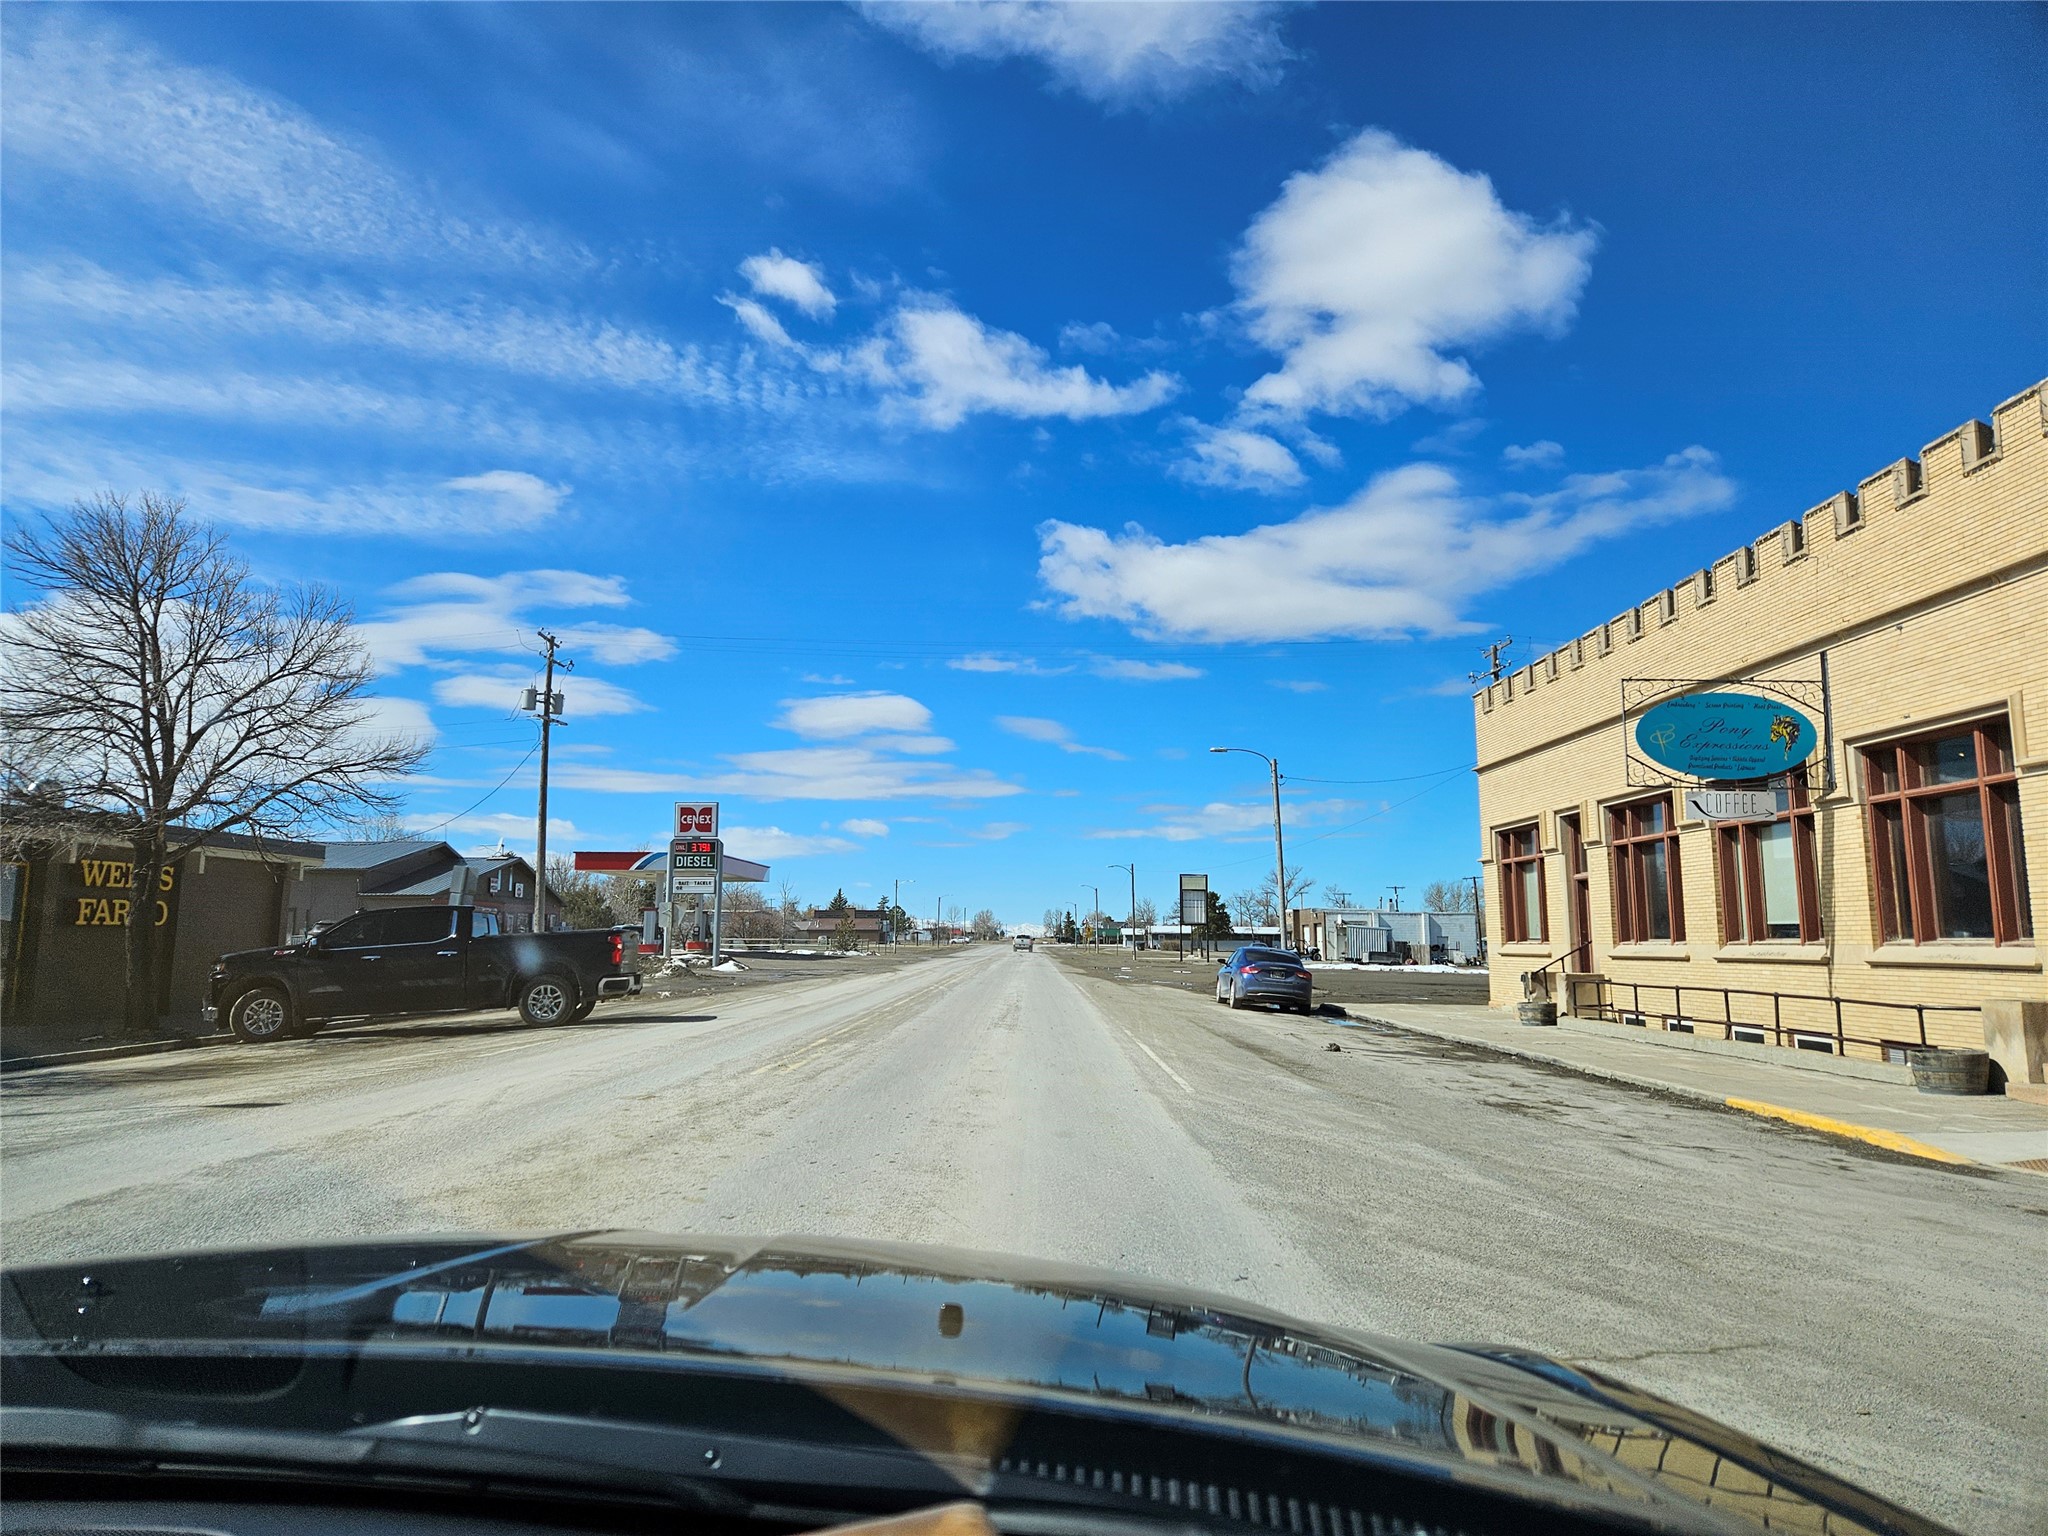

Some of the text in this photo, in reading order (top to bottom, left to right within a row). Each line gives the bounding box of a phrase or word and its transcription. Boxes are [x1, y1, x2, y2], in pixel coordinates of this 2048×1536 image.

[1699, 717, 1753, 740] Pony
[1680, 733, 1769, 753] Expressions
[1706, 793, 1757, 814] COFFEE
[681, 815, 712, 825] CENEX
[676, 856, 713, 867] DIESEL
[81, 859, 174, 891] WES
[75, 899, 169, 926] FARO
